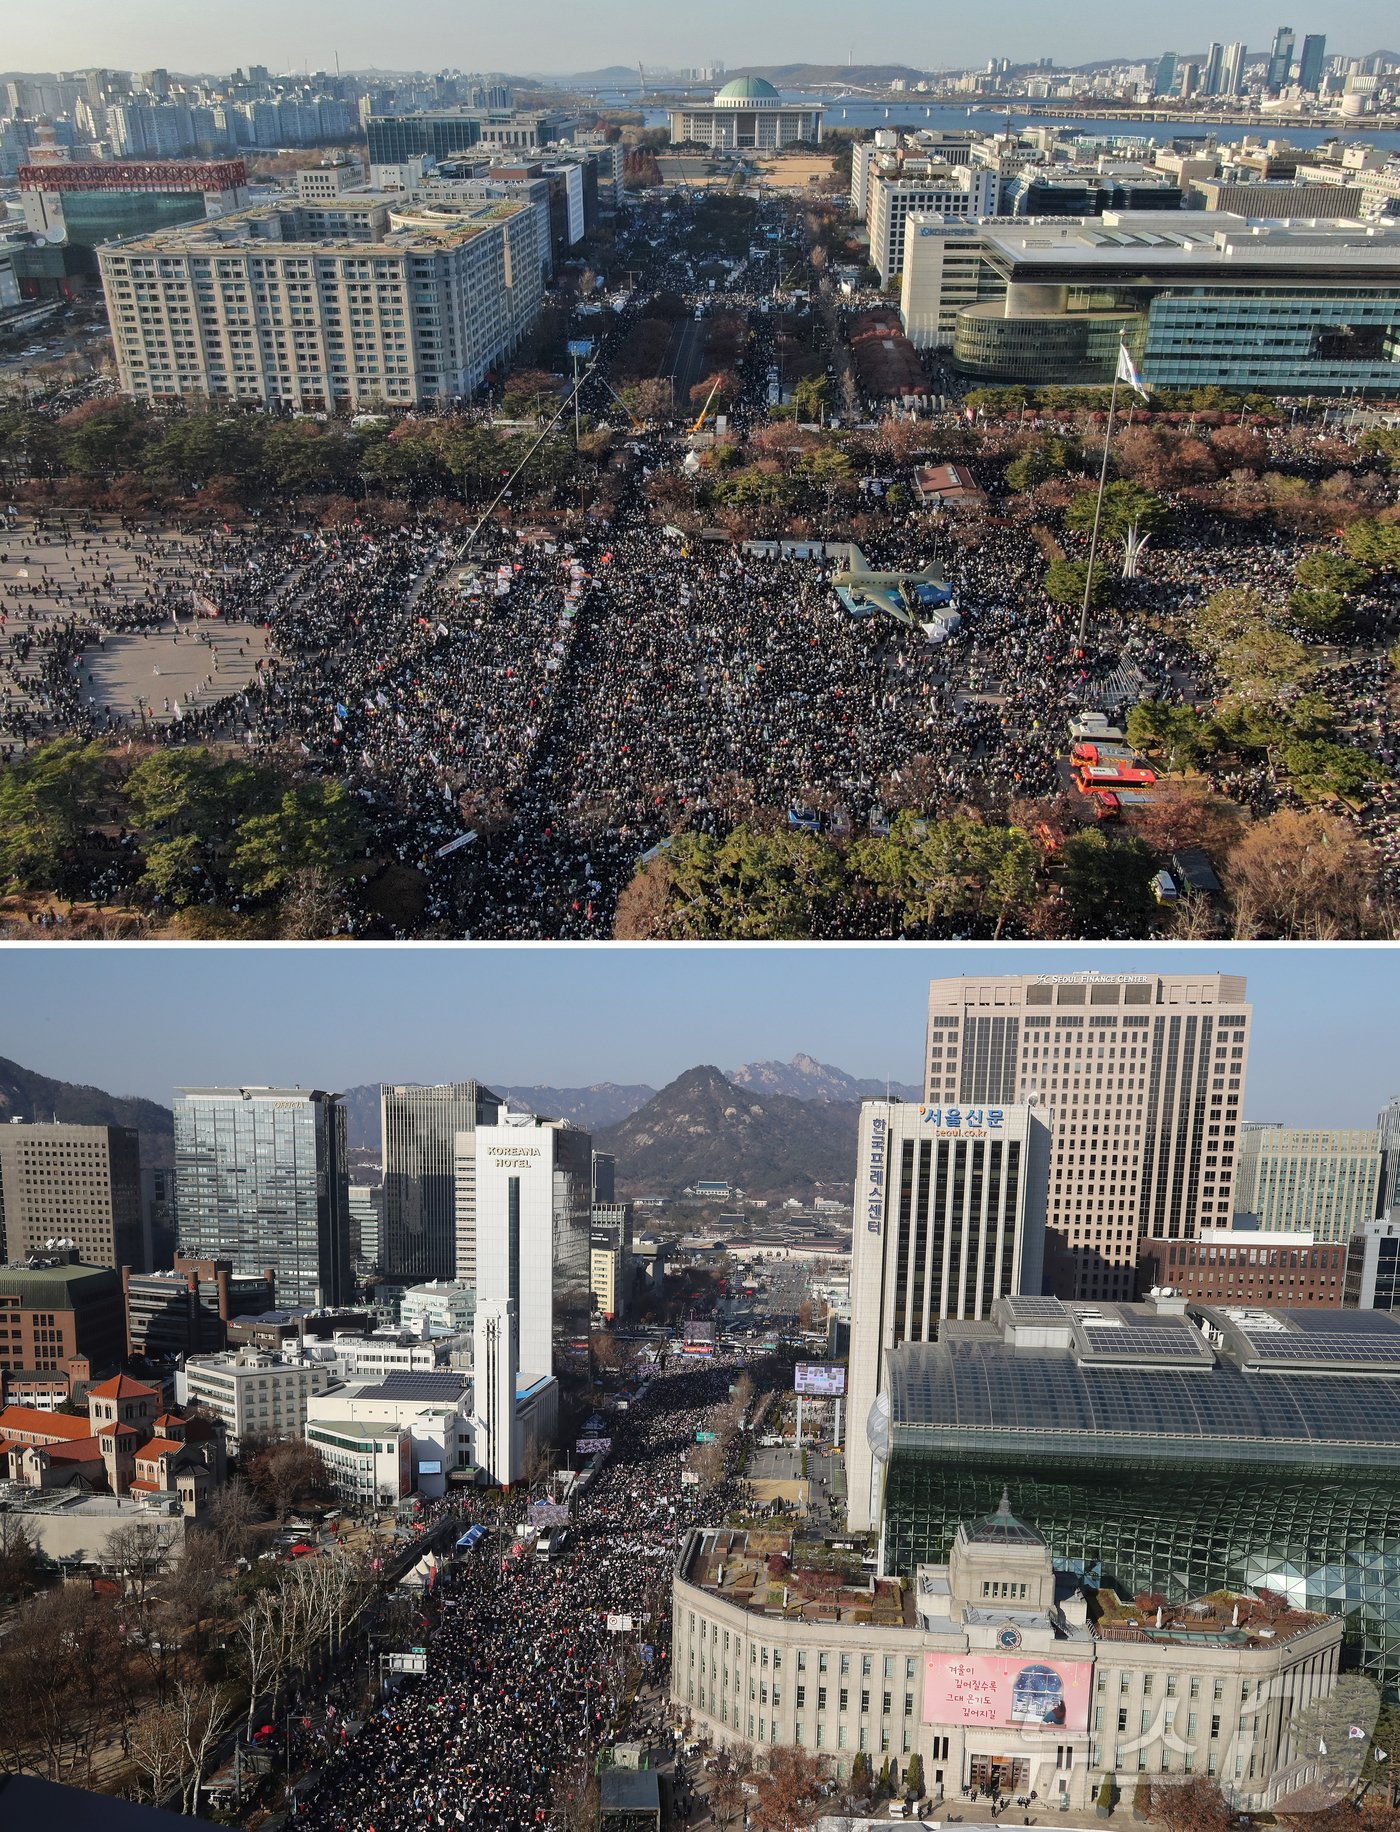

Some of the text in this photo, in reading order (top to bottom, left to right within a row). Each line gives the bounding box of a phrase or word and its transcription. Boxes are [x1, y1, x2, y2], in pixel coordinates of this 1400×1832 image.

[1081, 975, 1116, 984] FINANCE
[1117, 975, 1148, 983] CENTER
[935, 1129, 988, 1137] seoul.co.kr
[488, 1146, 541, 1156] KOREANA
[495, 1158, 532, 1168] HOTEL
[867, 1118, 887, 1236] 한국프레스센터
[948, 1664, 975, 1677] 겨울이
[954, 1678, 998, 1693] 깊어질수록
[945, 1693, 992, 1705] 그대 온기도
[962, 1707, 997, 1720] 깊어지길
